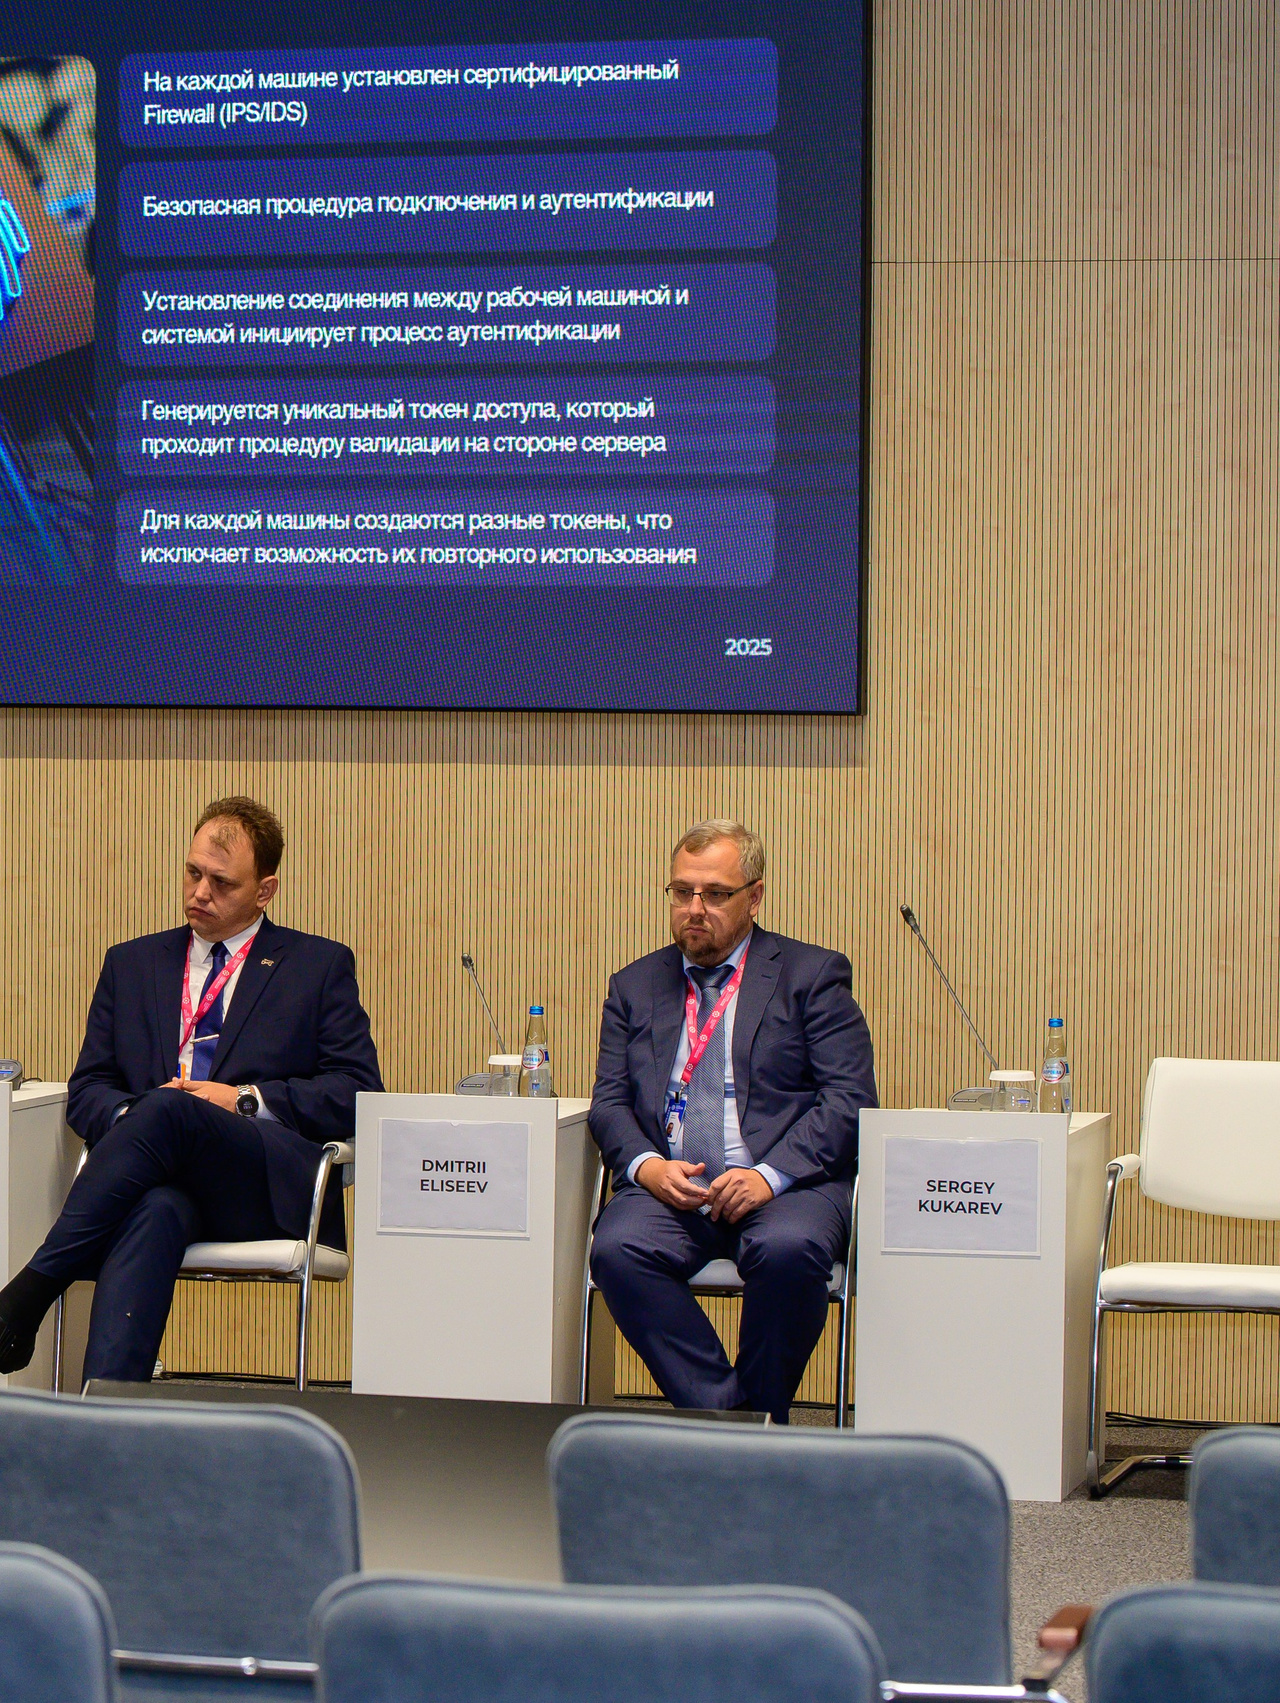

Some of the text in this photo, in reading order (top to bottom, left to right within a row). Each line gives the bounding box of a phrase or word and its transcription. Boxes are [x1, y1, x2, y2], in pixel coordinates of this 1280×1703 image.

[144, 58, 679, 93] На каждой машине установлен сертифицированный
[144, 100, 308, 129] Firewall (IPS/IDS)
[143, 187, 714, 220] Безопасная процедура подключения и аутентификации
[142, 284, 689, 313] Установление соединения между рабочей машиной и
[141, 319, 621, 348] системой инициирует процесс аутентификации
[142, 397, 655, 426] Генерируется уникальный токен доступа, который
[142, 435, 667, 459] проходит процедуру валидации на стороне сервера
[140, 509, 673, 536] Для каждой машины создаются разные токены, что
[141, 547, 697, 569] исключает возможность их повторного использования
[725, 638, 773, 656] 2025
[422, 1159, 486, 1174] DMITRII
[420, 1178, 488, 1194] ELISEEV
[926, 1179, 995, 1195] SERGEY
[918, 1199, 1003, 1215] KUKAREV
